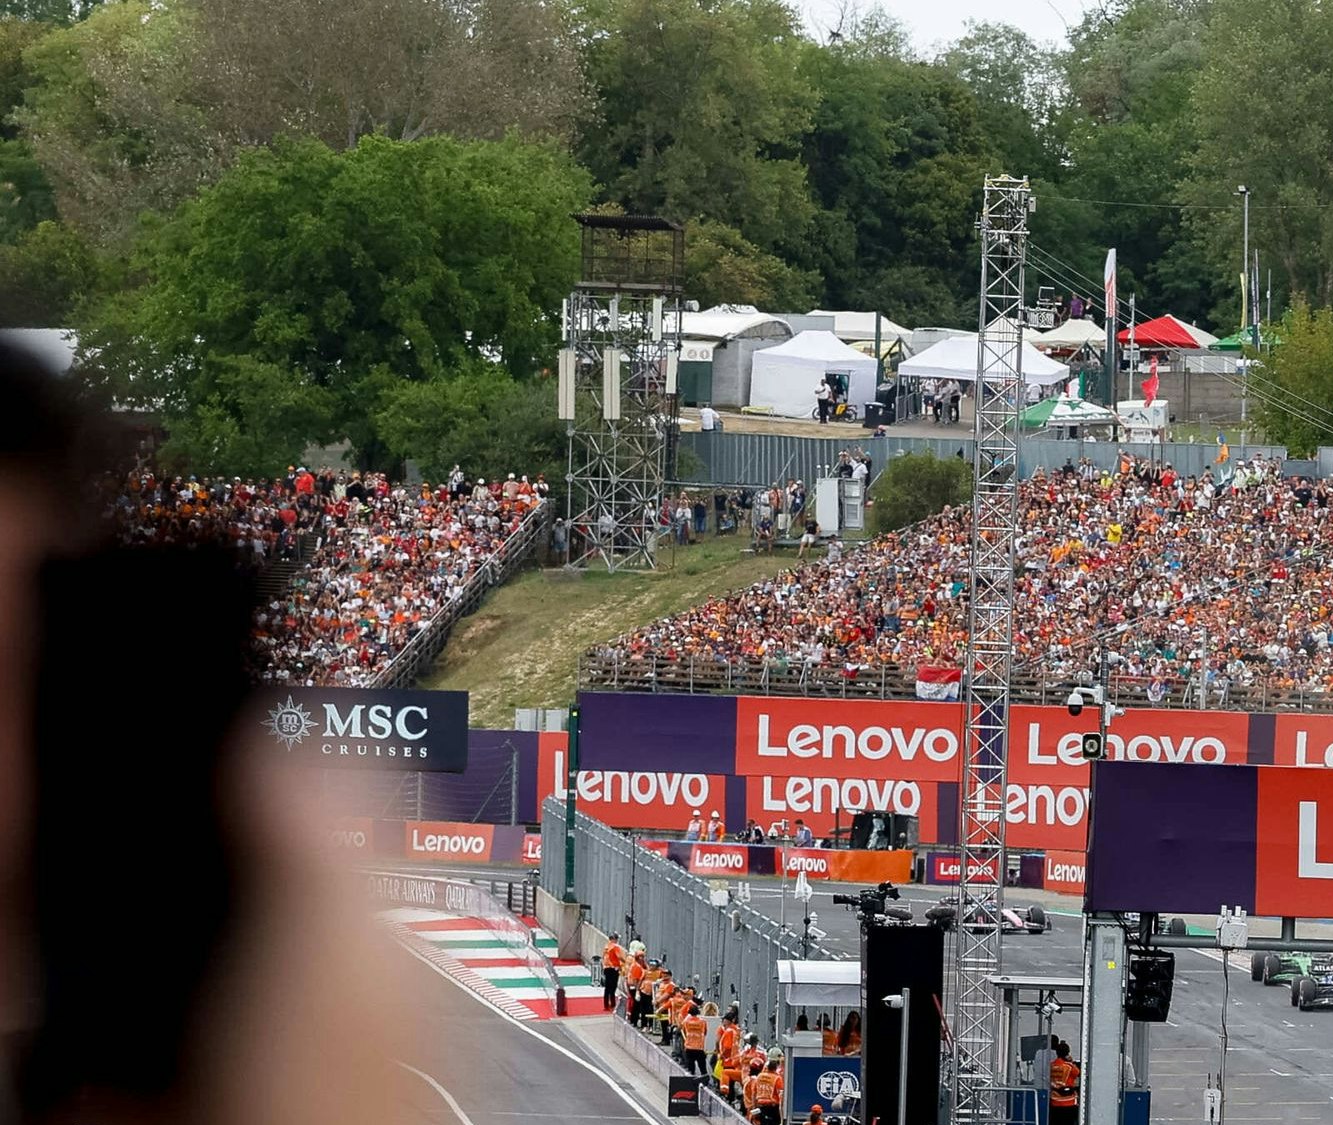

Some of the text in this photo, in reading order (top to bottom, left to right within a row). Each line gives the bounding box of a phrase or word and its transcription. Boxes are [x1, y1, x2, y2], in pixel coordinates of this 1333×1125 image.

[322, 703, 428, 740] MSC
[322, 744, 428, 758] CRUISES
[758, 714, 958, 761] Lenovo
[1028, 723, 1226, 765] Lenovo
[555, 751, 709, 806] Lenovo
[763, 776, 921, 816] Lenovo
[977, 783, 1089, 826] Leno
[413, 829, 484, 854] Lenovo
[695, 849, 743, 869] Lenovo
[782, 852, 827, 873] Lenovo
[1047, 859, 1085, 882] Lenov
[401, 879, 435, 904] AIRWAYS
